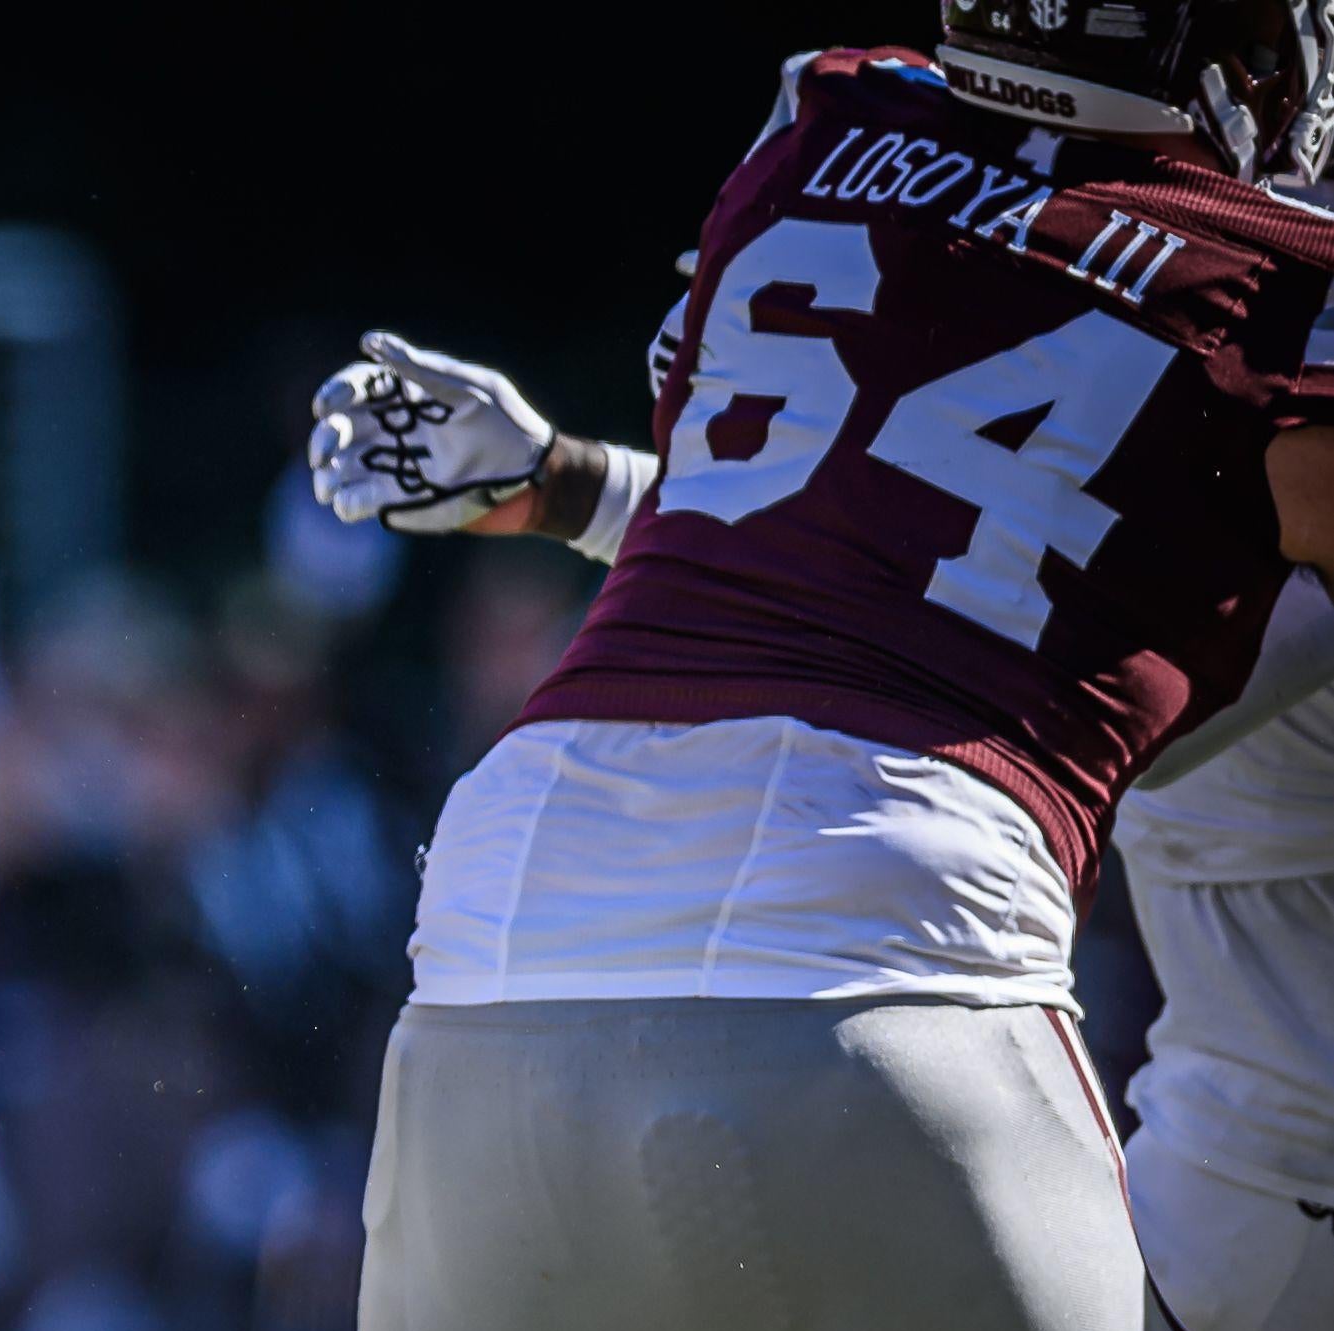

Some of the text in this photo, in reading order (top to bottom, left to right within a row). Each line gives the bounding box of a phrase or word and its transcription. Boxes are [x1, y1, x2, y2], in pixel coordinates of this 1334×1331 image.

[802, 127, 1187, 304] LOSOYA III
[655, 216, 1180, 652] 64
